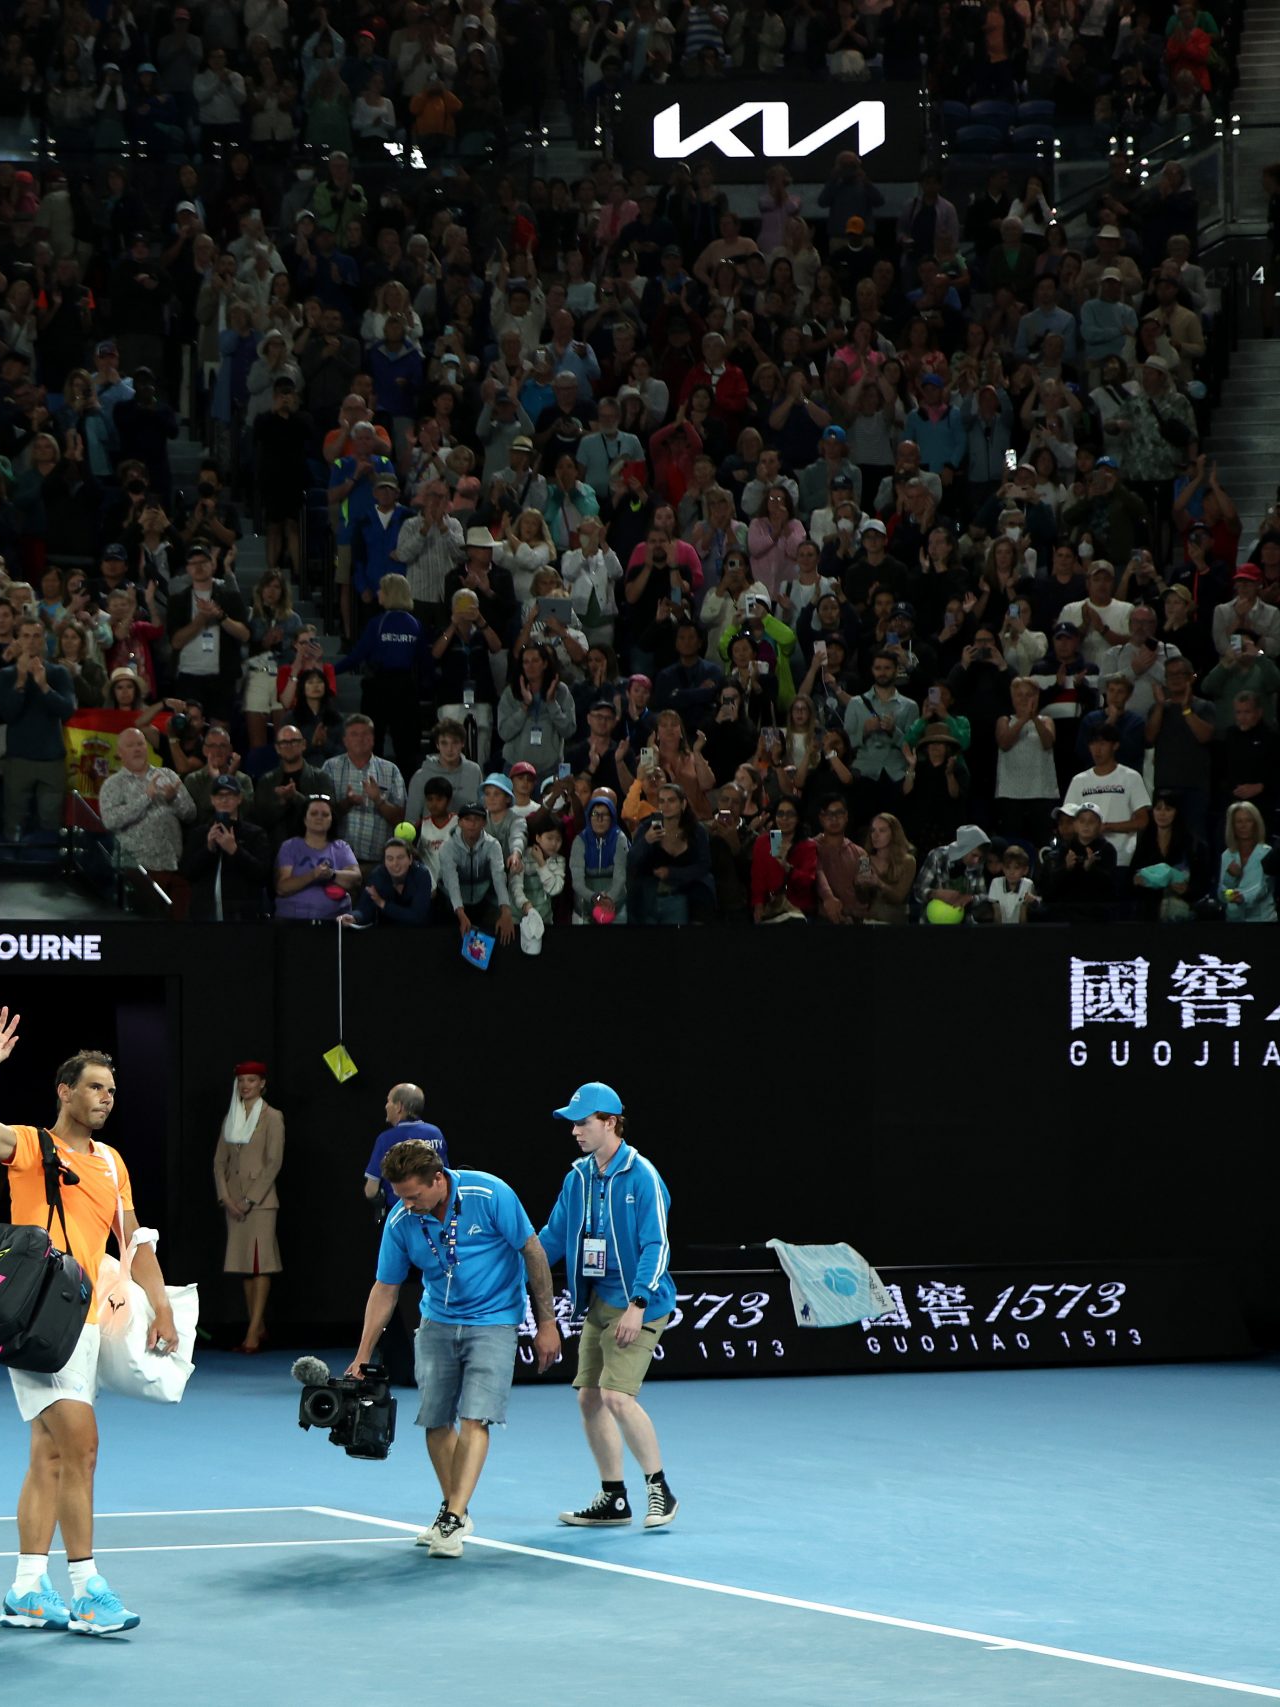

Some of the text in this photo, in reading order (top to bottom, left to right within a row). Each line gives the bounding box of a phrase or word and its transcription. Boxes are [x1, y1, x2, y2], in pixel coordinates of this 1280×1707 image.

[699, 1339, 785, 1359] 1573
[864, 1328, 1142, 1354] GUOJIAO 1573
